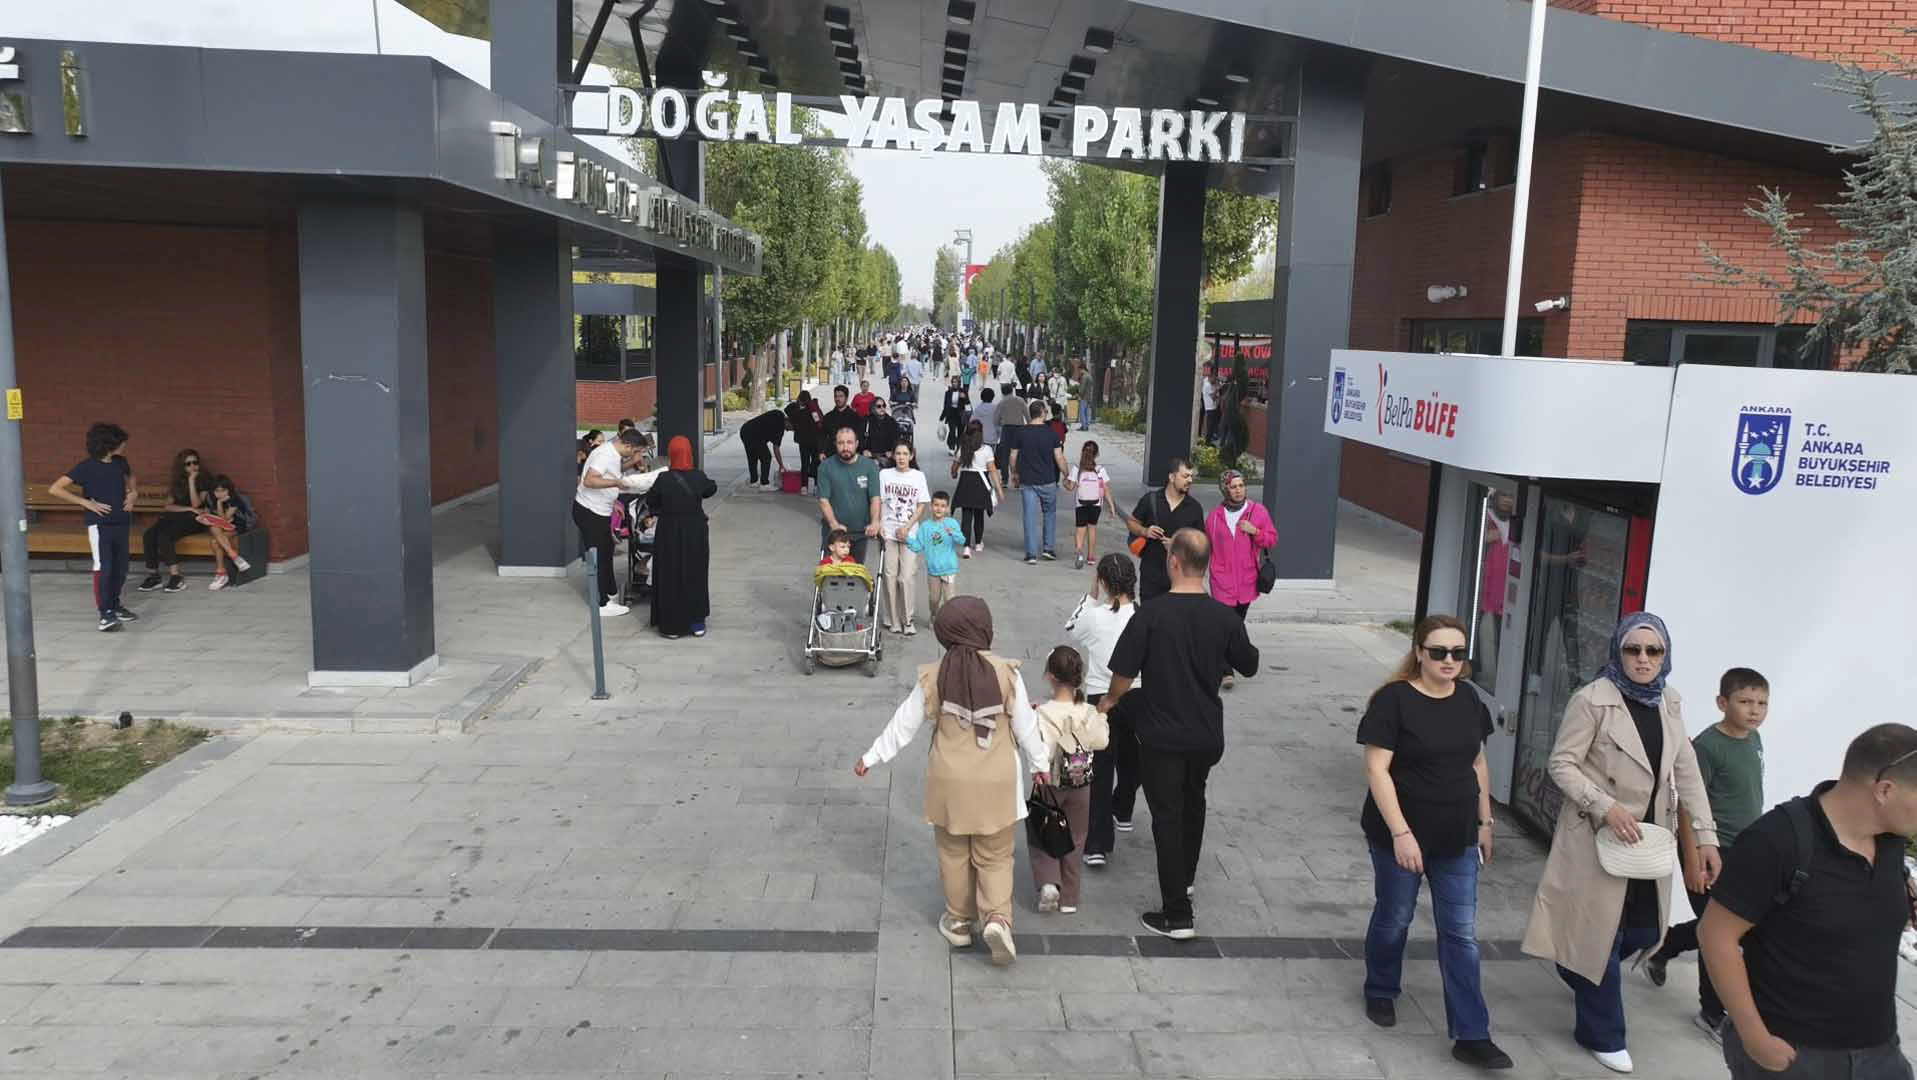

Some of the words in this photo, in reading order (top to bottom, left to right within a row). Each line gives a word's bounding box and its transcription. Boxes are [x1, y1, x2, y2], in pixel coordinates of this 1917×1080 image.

[606, 71, 801, 146] DOĞAL
[841, 96, 1042, 157] YAŞAM
[1072, 104, 1248, 164] PARKI
[1384, 394, 1414, 429] BelPa
[1413, 391, 1459, 438] BÜFE
[1740, 405, 1793, 414] ANKARA
[1804, 423, 1831, 437] T.C.
[1801, 440, 1864, 455] ANKARA
